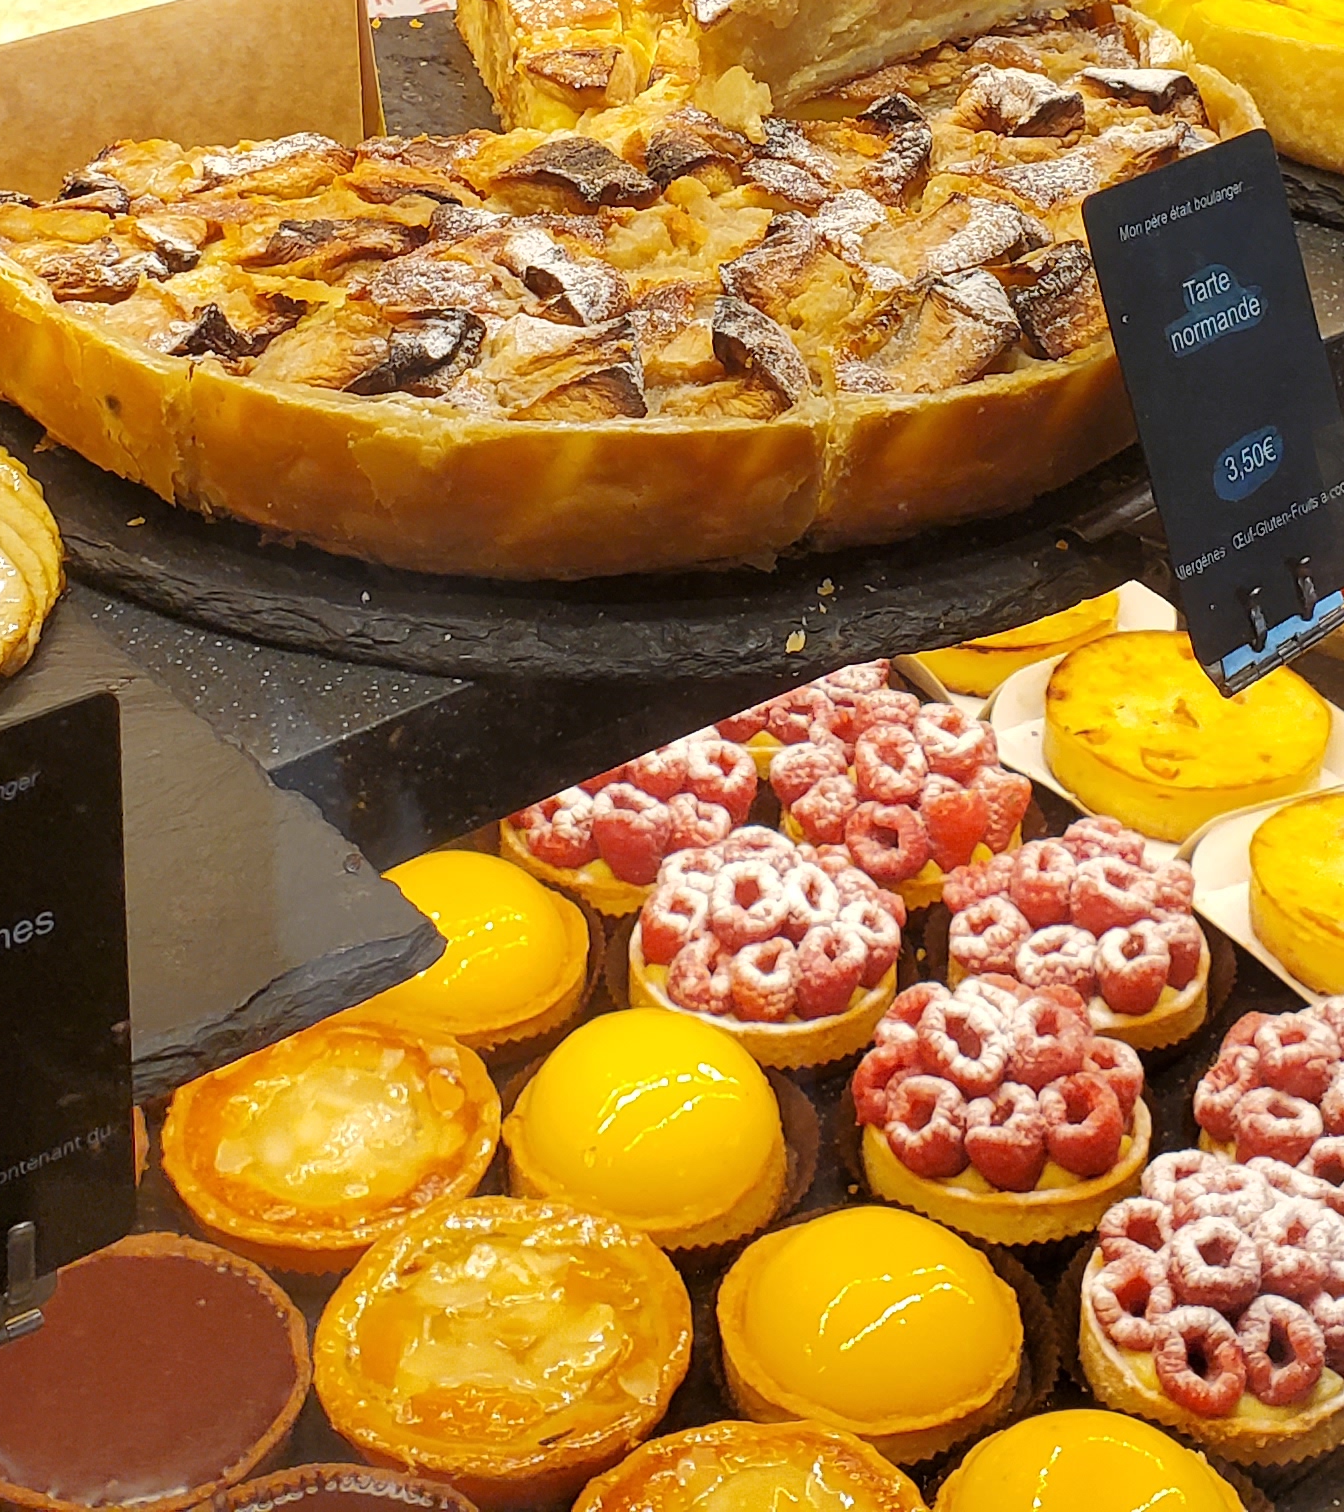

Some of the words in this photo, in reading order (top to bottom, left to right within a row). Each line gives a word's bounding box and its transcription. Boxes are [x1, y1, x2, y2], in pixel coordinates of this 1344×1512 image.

[1119, 223, 1143, 242] Mon
[1144, 213, 1168, 236] père
[1169, 201, 1193, 221] était
[1182, 271, 1232, 305] Tarte
[1171, 296, 1262, 352] normande
[1224, 436, 1277, 482] 3,50€
